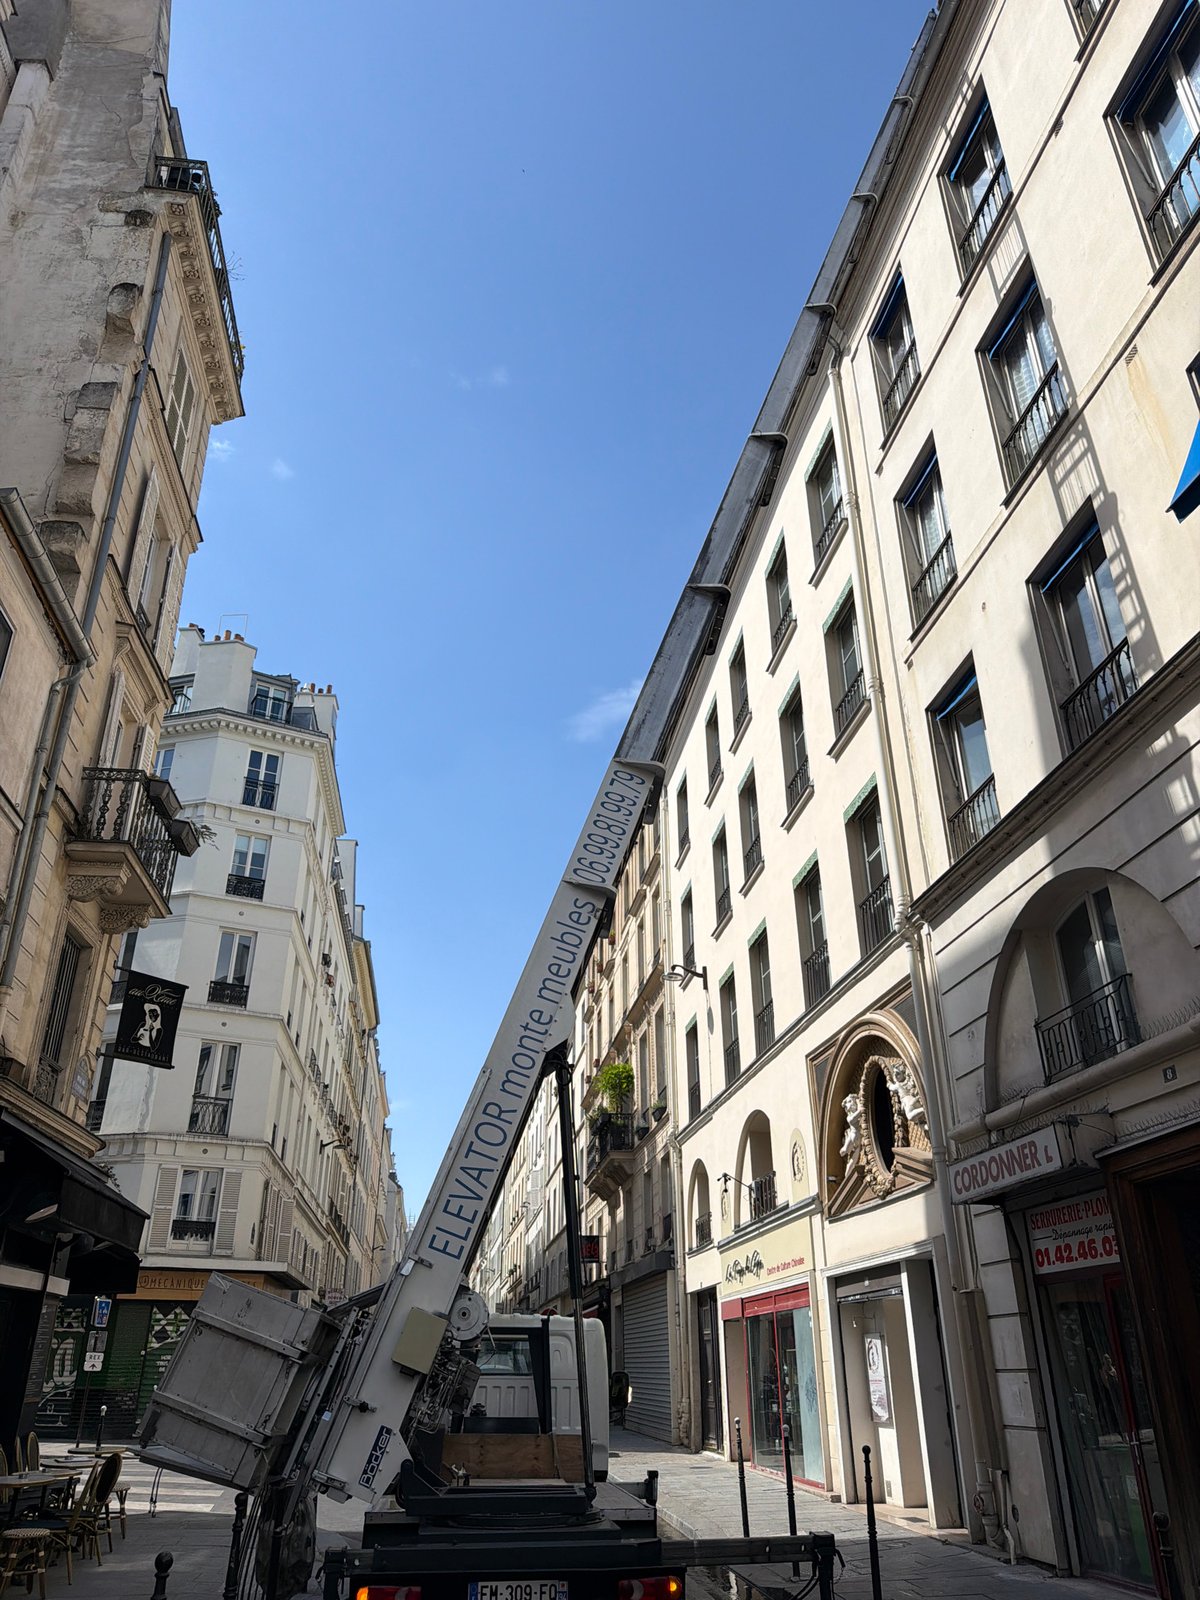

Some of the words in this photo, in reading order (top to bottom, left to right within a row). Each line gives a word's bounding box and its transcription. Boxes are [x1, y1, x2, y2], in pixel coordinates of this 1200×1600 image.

[572, 769, 646, 884] 06.99.81.99.79
[428, 1101, 518, 1261] ELEVATOR
[500, 1009, 554, 1099] monte
[537, 897, 596, 1005] meubles
[1166, 1068, 1173, 1079] 8
[953, 1140, 1042, 1195] CORDONNER
[766, 1267, 776, 1276] Centre
[780, 1261, 791, 1271] Culture
[791, 1256, 805, 1268] Chinoise
[359, 1427, 391, 1488] Böcker
